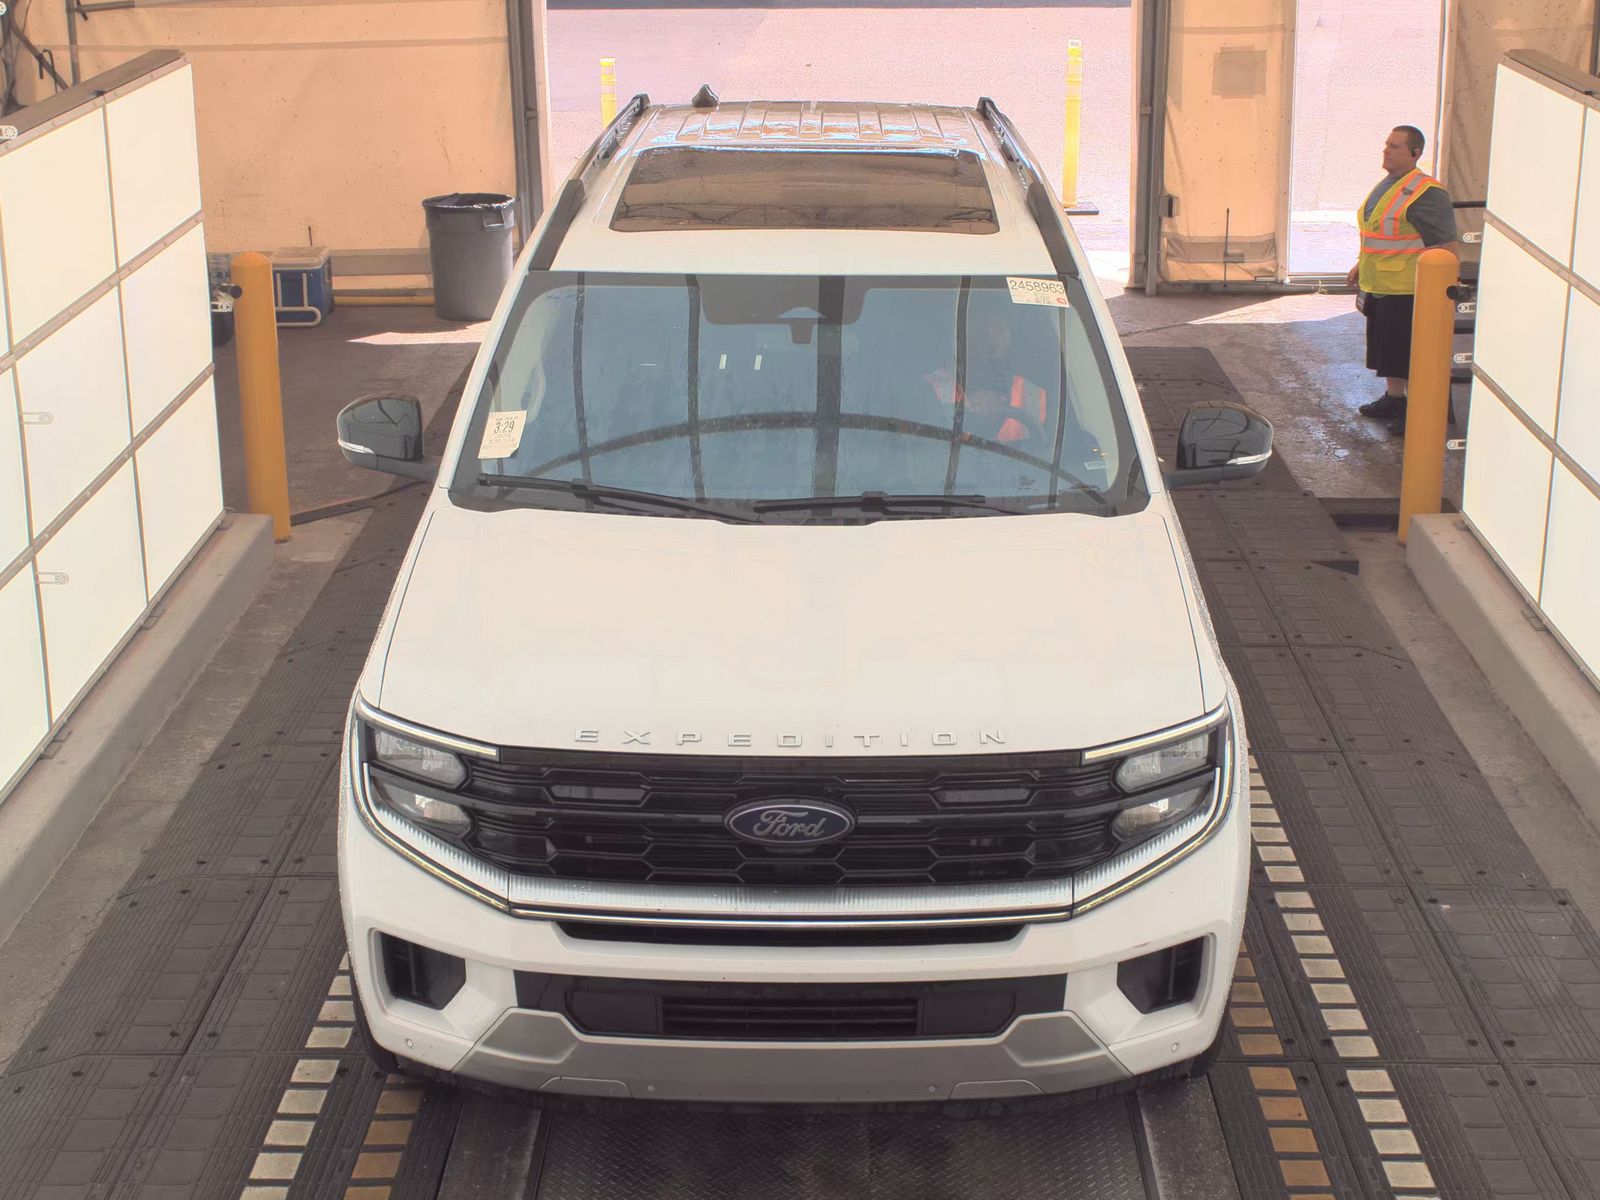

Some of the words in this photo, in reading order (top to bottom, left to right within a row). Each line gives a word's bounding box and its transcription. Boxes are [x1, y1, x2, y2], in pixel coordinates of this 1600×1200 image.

[1009, 279, 1065, 295] 2458963
[574, 728, 1006, 748] EXPEDITION
[752, 809, 827, 837] Ford
